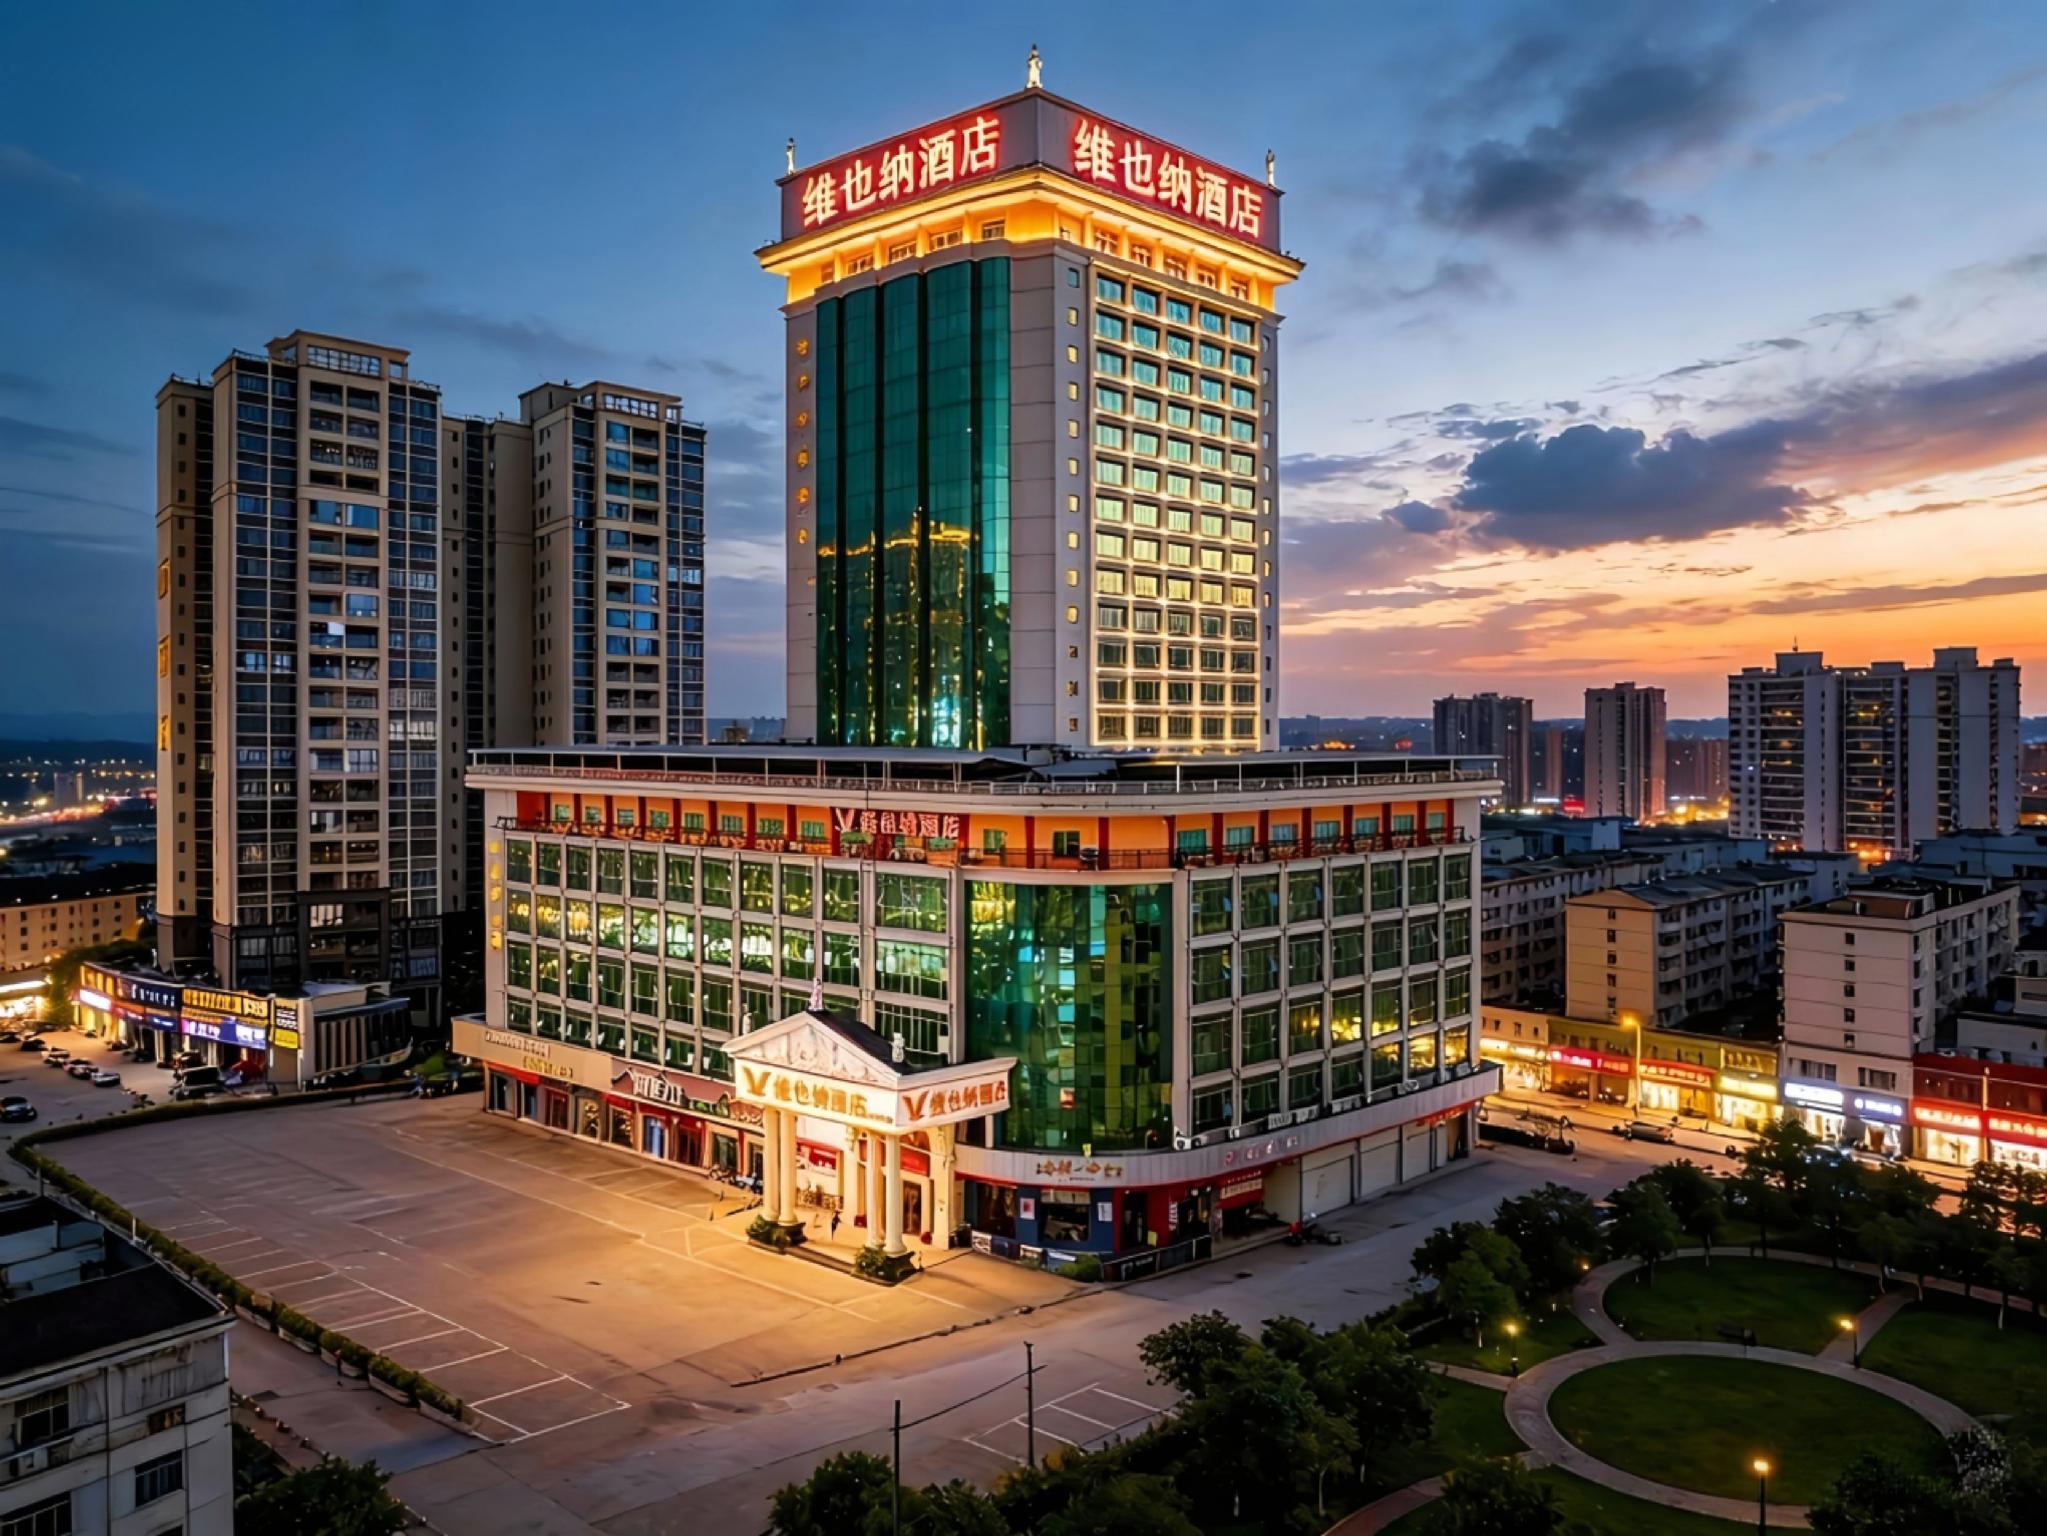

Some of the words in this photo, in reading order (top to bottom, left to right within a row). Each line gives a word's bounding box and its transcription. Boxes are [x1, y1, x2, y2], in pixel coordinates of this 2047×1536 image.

[803, 116, 999, 227] 维也纳酒店
[1074, 119, 1262, 238] 维也纳酒店
